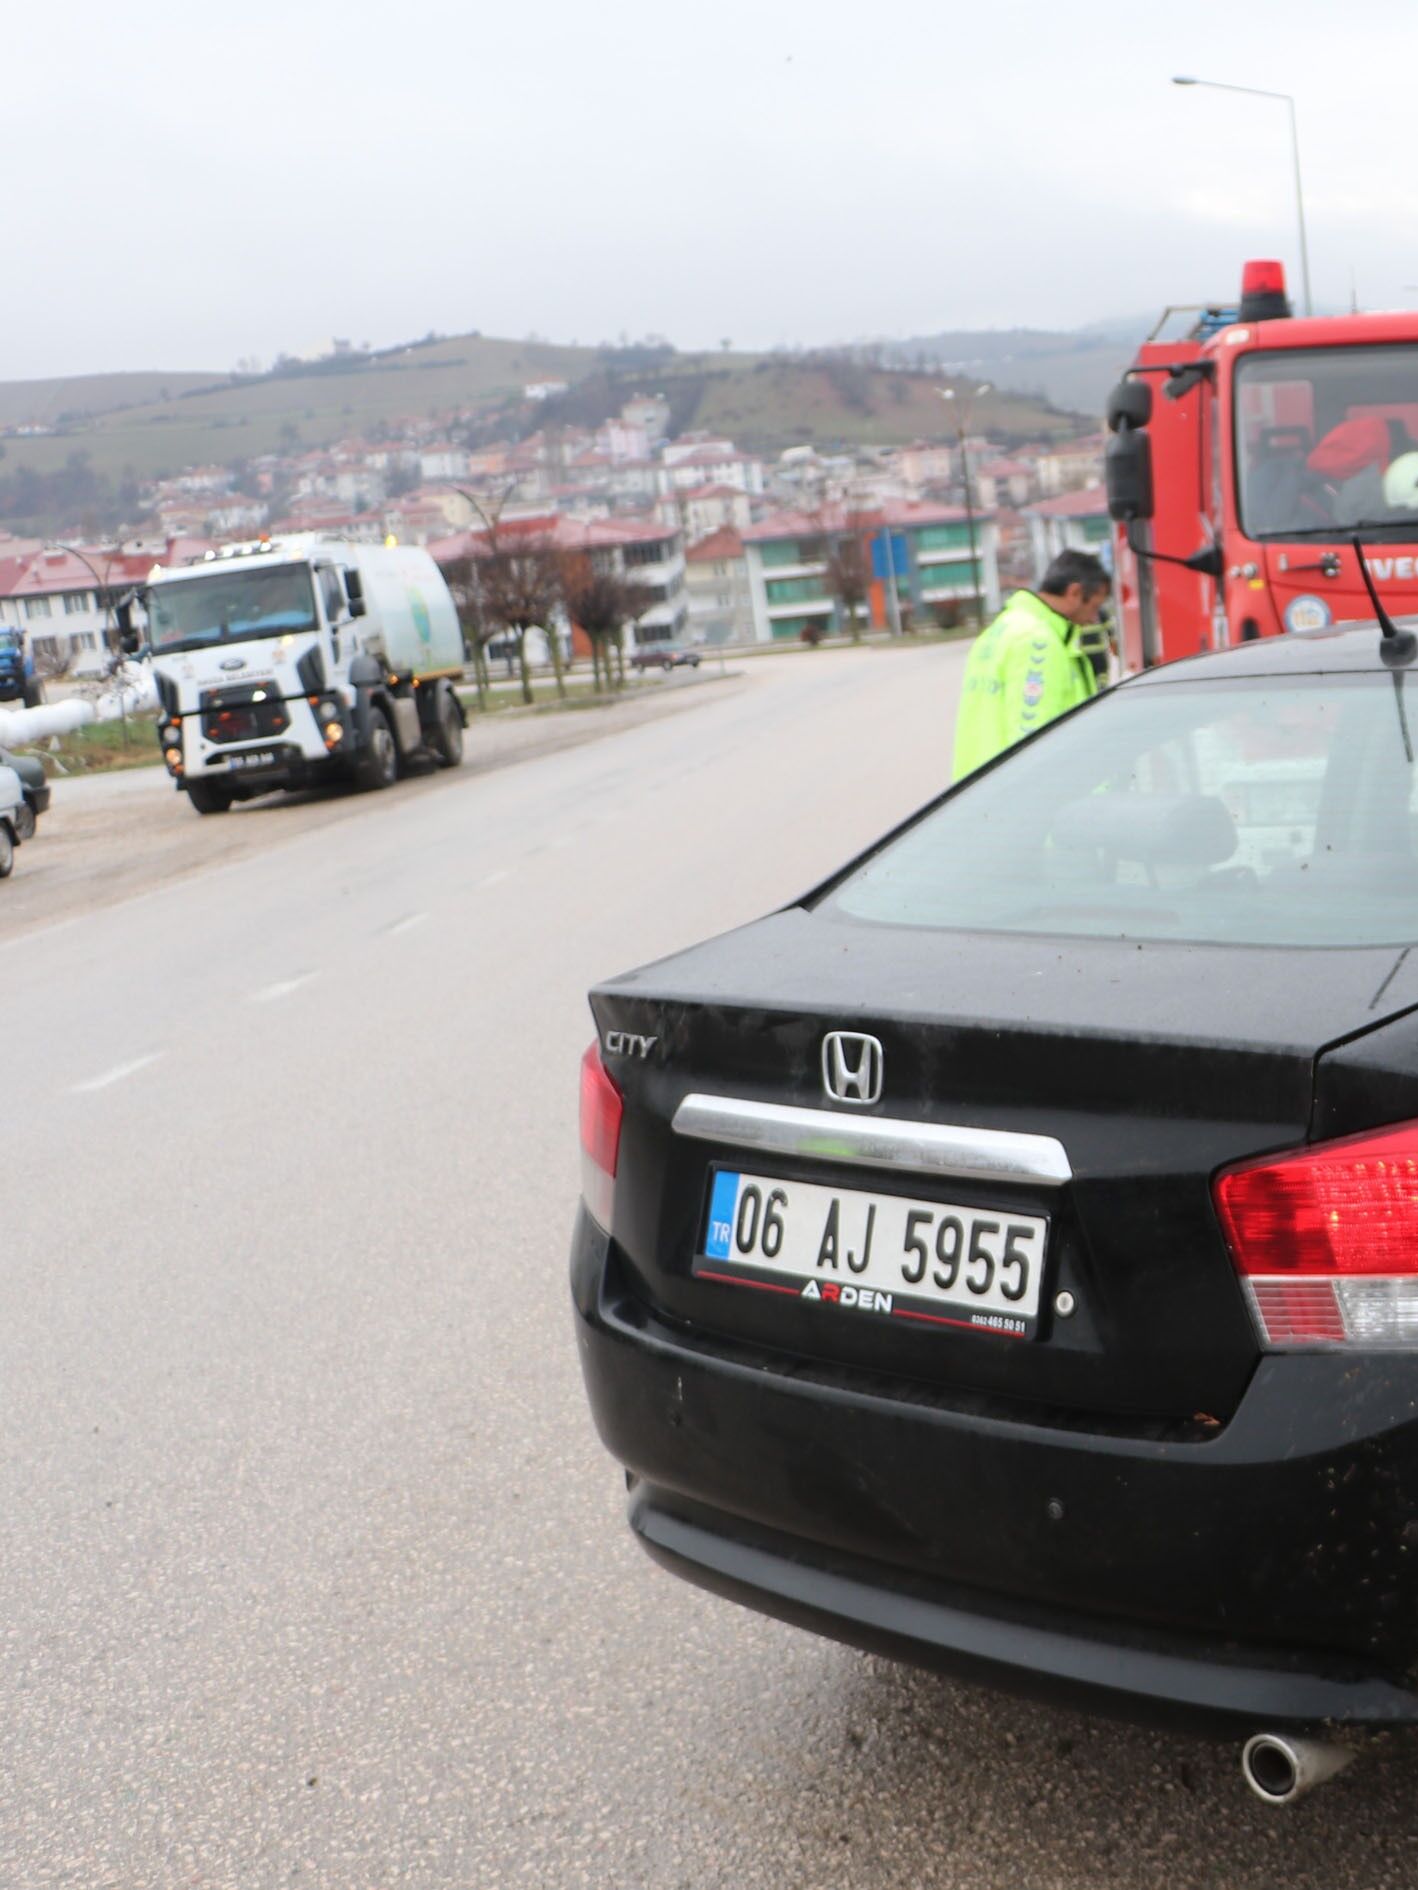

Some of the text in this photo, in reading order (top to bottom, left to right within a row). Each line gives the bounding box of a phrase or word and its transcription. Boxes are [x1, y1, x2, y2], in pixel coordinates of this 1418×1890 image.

[606, 1030, 657, 1058] CITY
[712, 1221, 731, 1244] TR
[736, 1183, 1036, 1302] 06 AJ 5955
[801, 1279, 893, 1314] ARDEN
